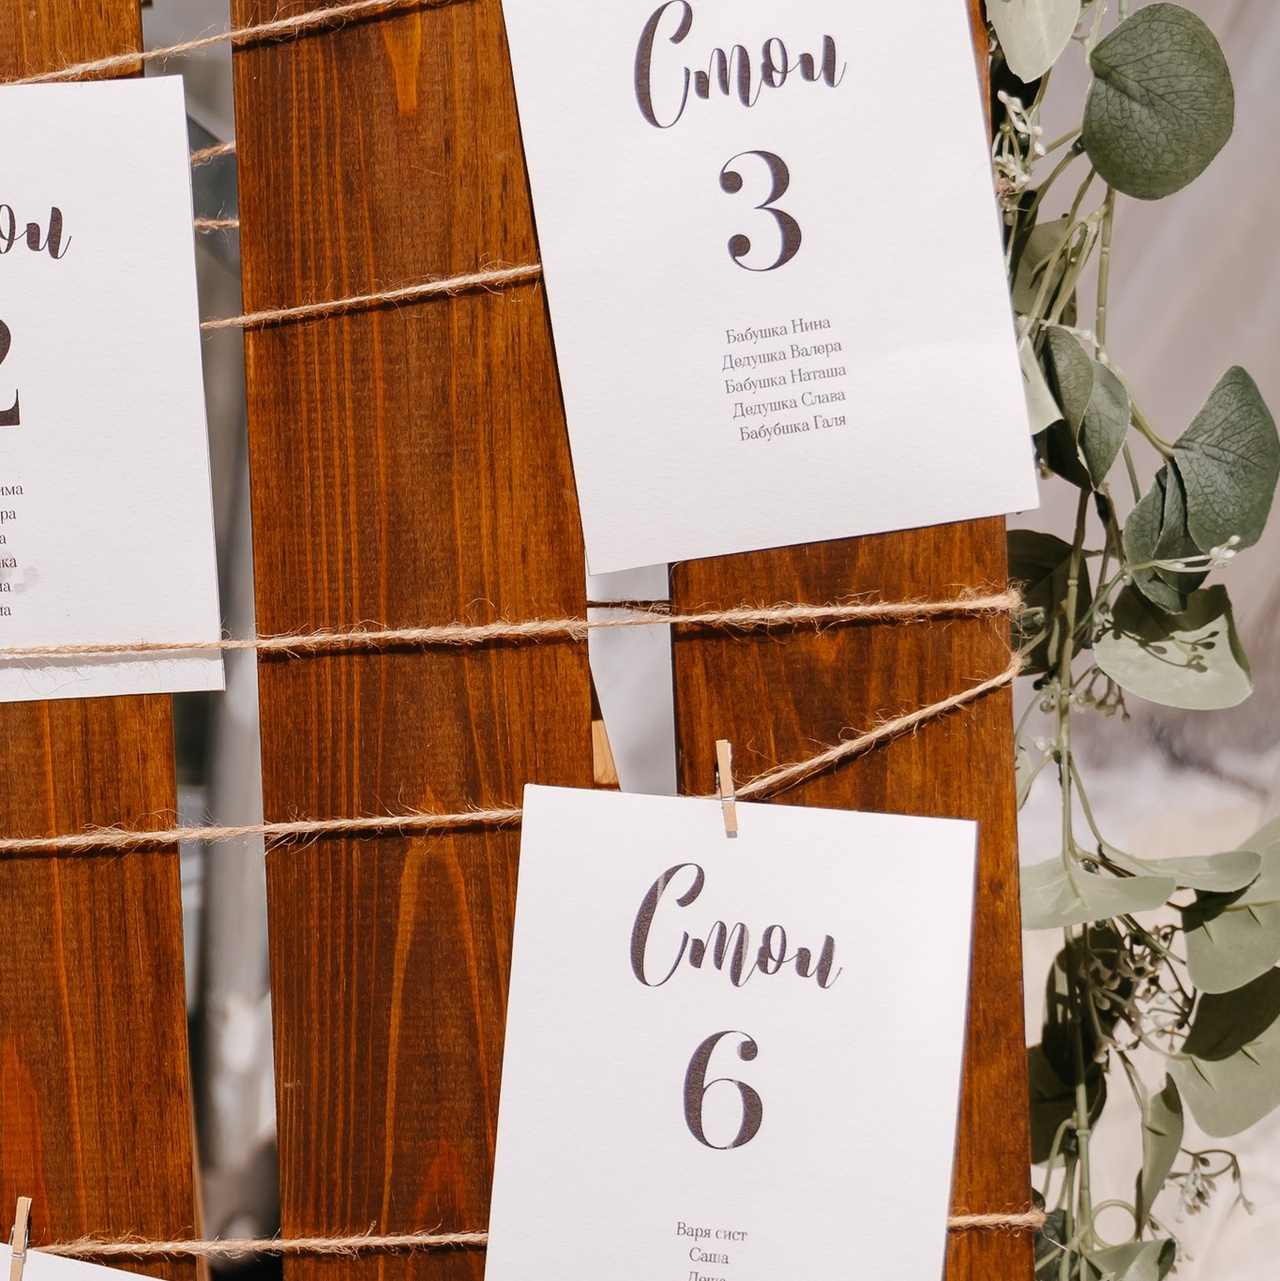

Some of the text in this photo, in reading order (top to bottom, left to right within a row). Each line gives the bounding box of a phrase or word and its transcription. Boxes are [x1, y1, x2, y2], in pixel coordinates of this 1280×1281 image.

[634, 0, 846, 128] Стол
[719, 150, 802, 271] 3
[725, 318, 831, 345] Бабушка Нина
[722, 341, 843, 372] Дедушка Валера
[724, 365, 847, 395] Бабушка Наташа
[732, 390, 846, 420] Дедушка Слава
[813, 414, 846, 430] Галя
[630, 863, 842, 989] Стол
[684, 1031, 763, 1150] 6
[676, 1221, 711, 1241] Варя
[689, 1247, 729, 1264] Саша
